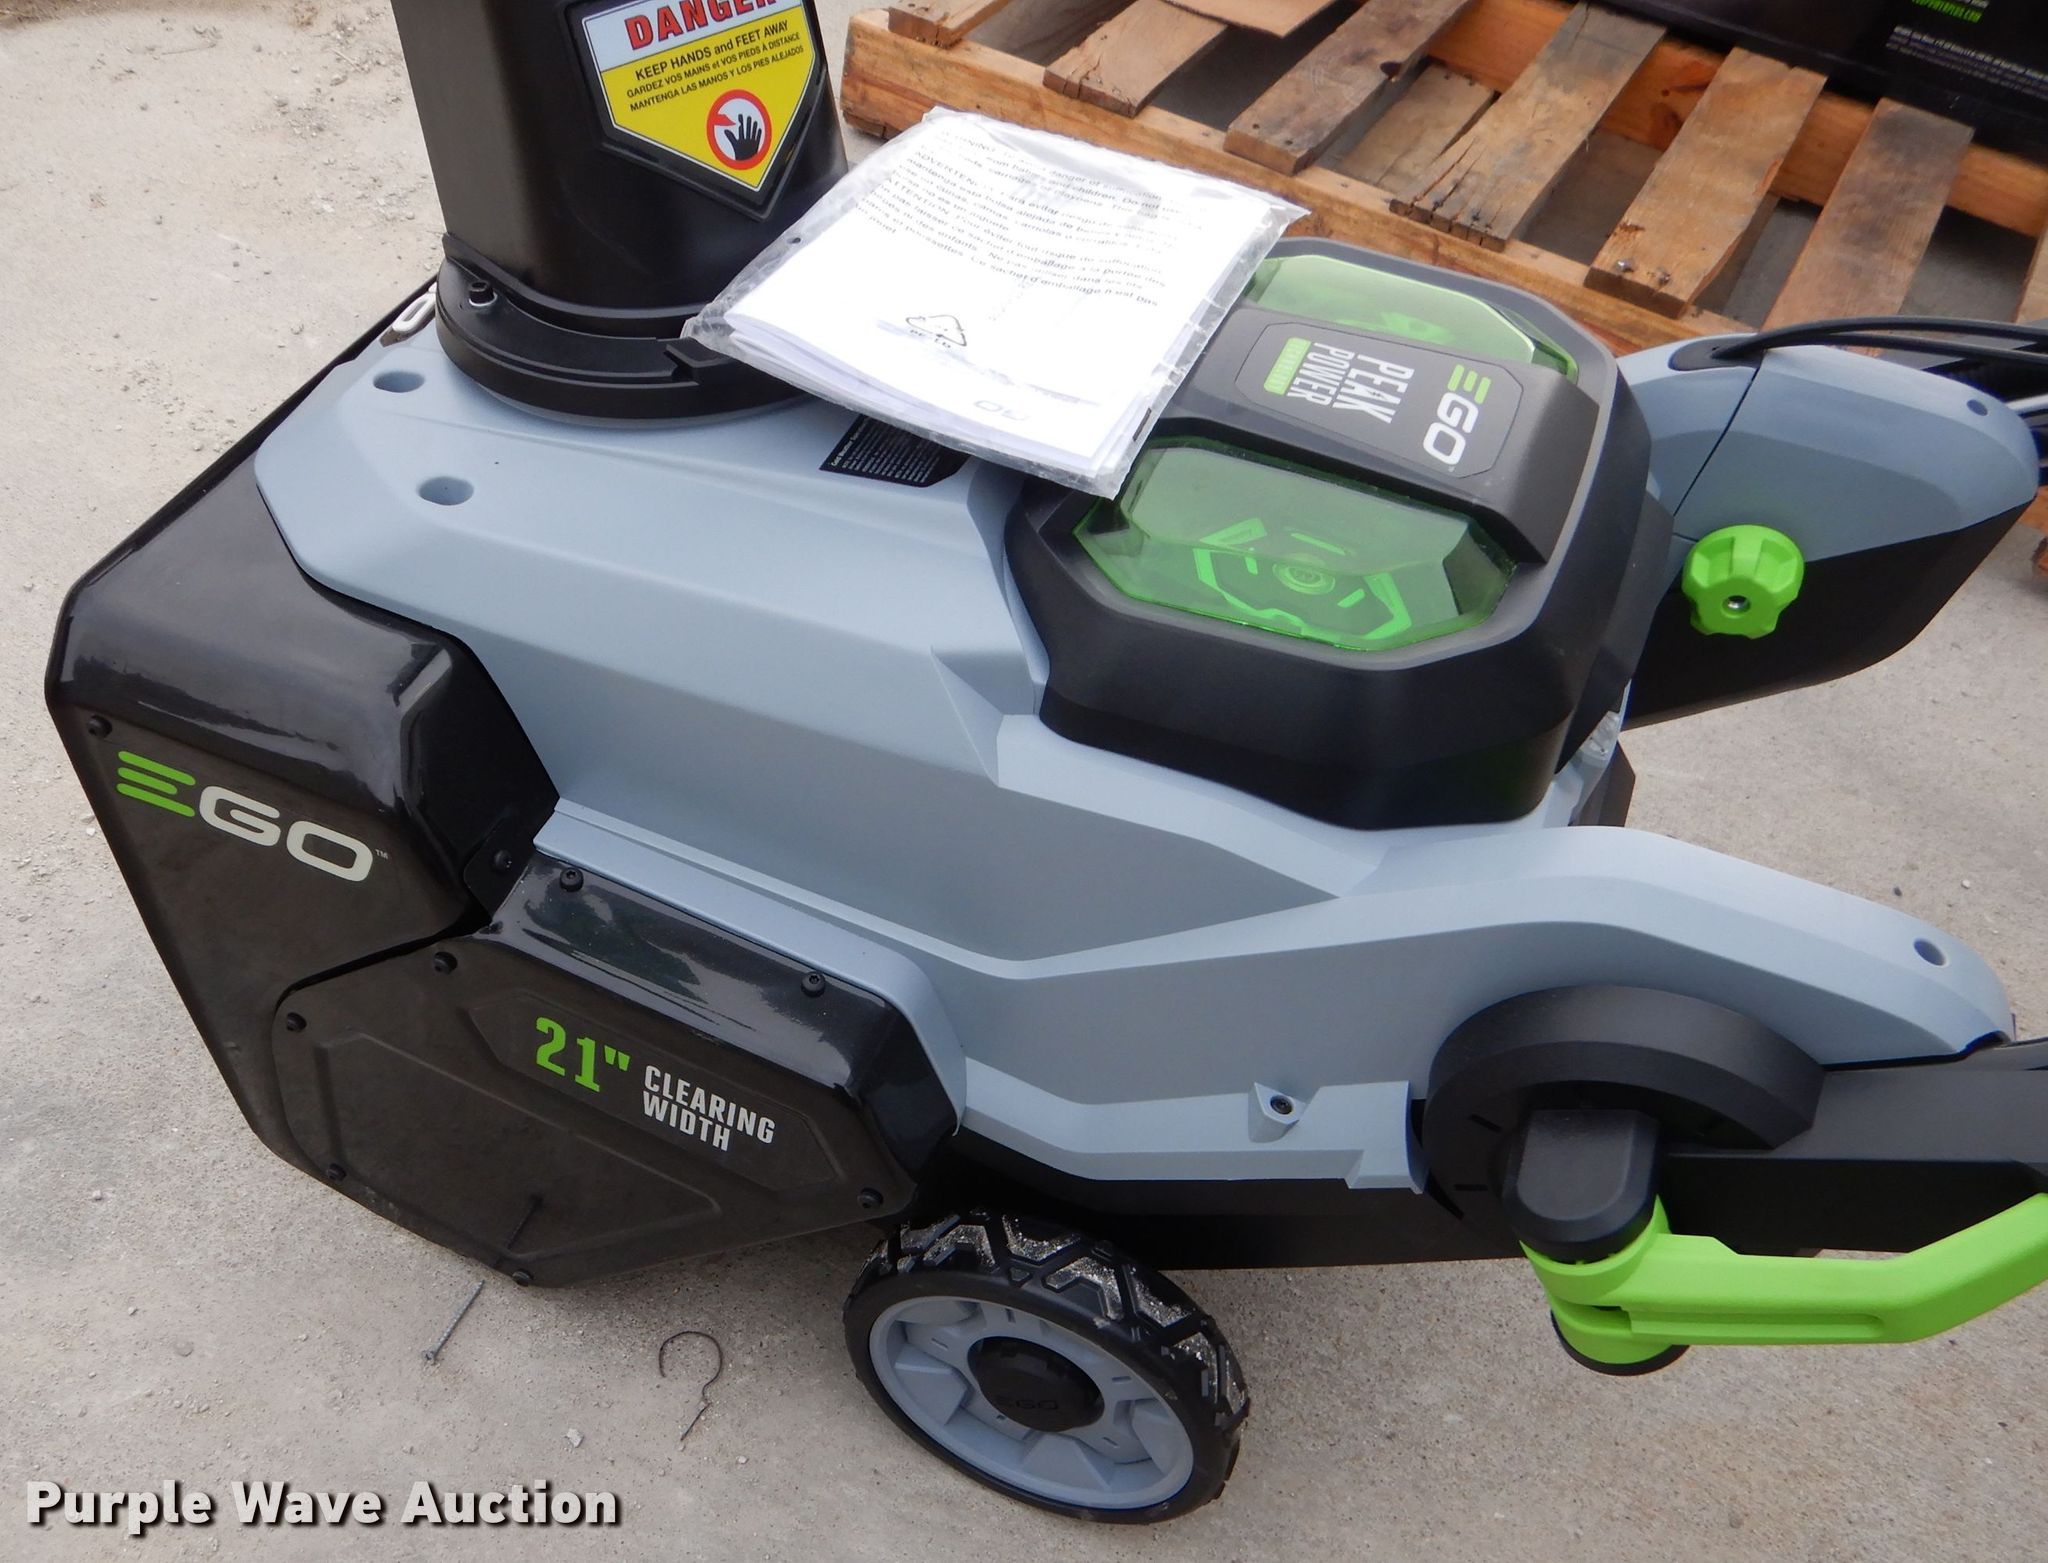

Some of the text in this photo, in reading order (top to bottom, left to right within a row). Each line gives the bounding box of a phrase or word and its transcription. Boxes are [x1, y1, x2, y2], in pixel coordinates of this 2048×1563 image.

[626, 80, 663, 98] GARDEZ
[665, 73, 682, 85] VOS
[684, 63, 711, 79] MAINS
[712, 61, 720, 69] et
[721, 54, 737, 65] VOS
[738, 46, 761, 60] PIEDS
[768, 32, 800, 49] DISTANCE
[630, 45, 804, 112] MANTENGA LAS MANOS Y LOS PIES ALEJADOS
[635, 20, 788, 80] KEEP HANDS and FEET AWAY
[1286, 342, 1355, 406] POWER
[1332, 354, 1415, 424] PEAK
[1422, 364, 1491, 465] EGO
[116, 750, 373, 882] EGO
[536, 1016, 630, 1092] 21"
[643, 1091, 731, 1151] WIDTH
[644, 1065, 775, 1144] CLEARING
